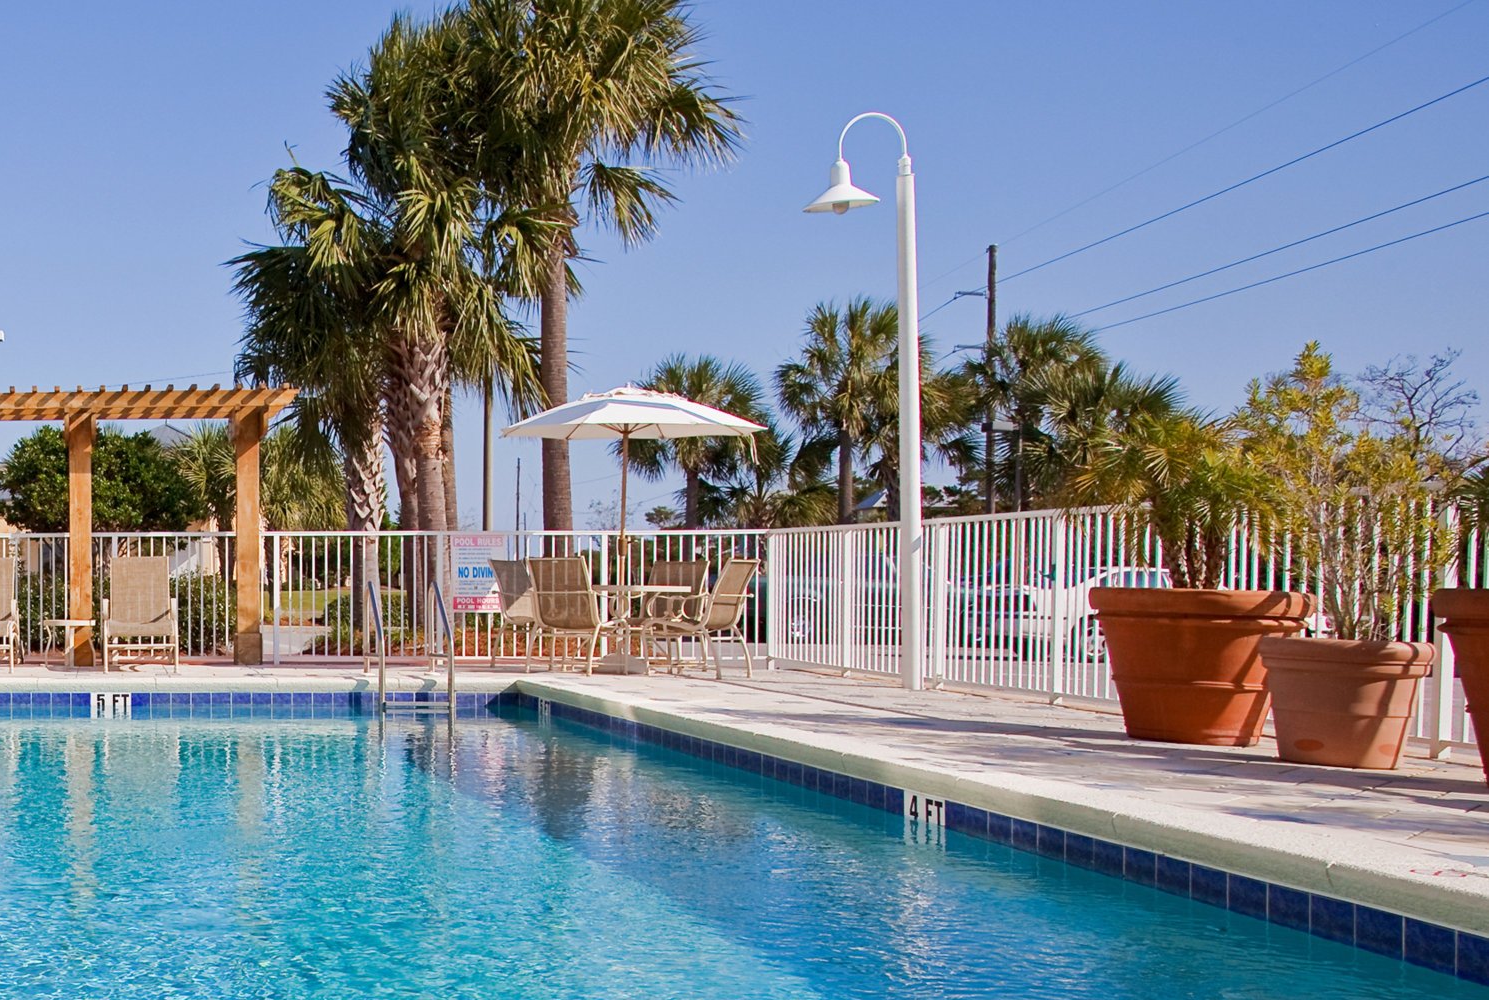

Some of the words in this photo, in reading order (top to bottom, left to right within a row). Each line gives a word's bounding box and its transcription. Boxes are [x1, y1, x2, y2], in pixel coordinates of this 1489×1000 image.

[454, 538, 475, 546] POOL
[477, 538, 502, 546] RULES
[458, 566, 469, 578] NO
[472, 566, 495, 578] DIVIN
[112, 694, 129, 709] FT
[909, 795, 918, 820] 4
[925, 798, 943, 826] FT
